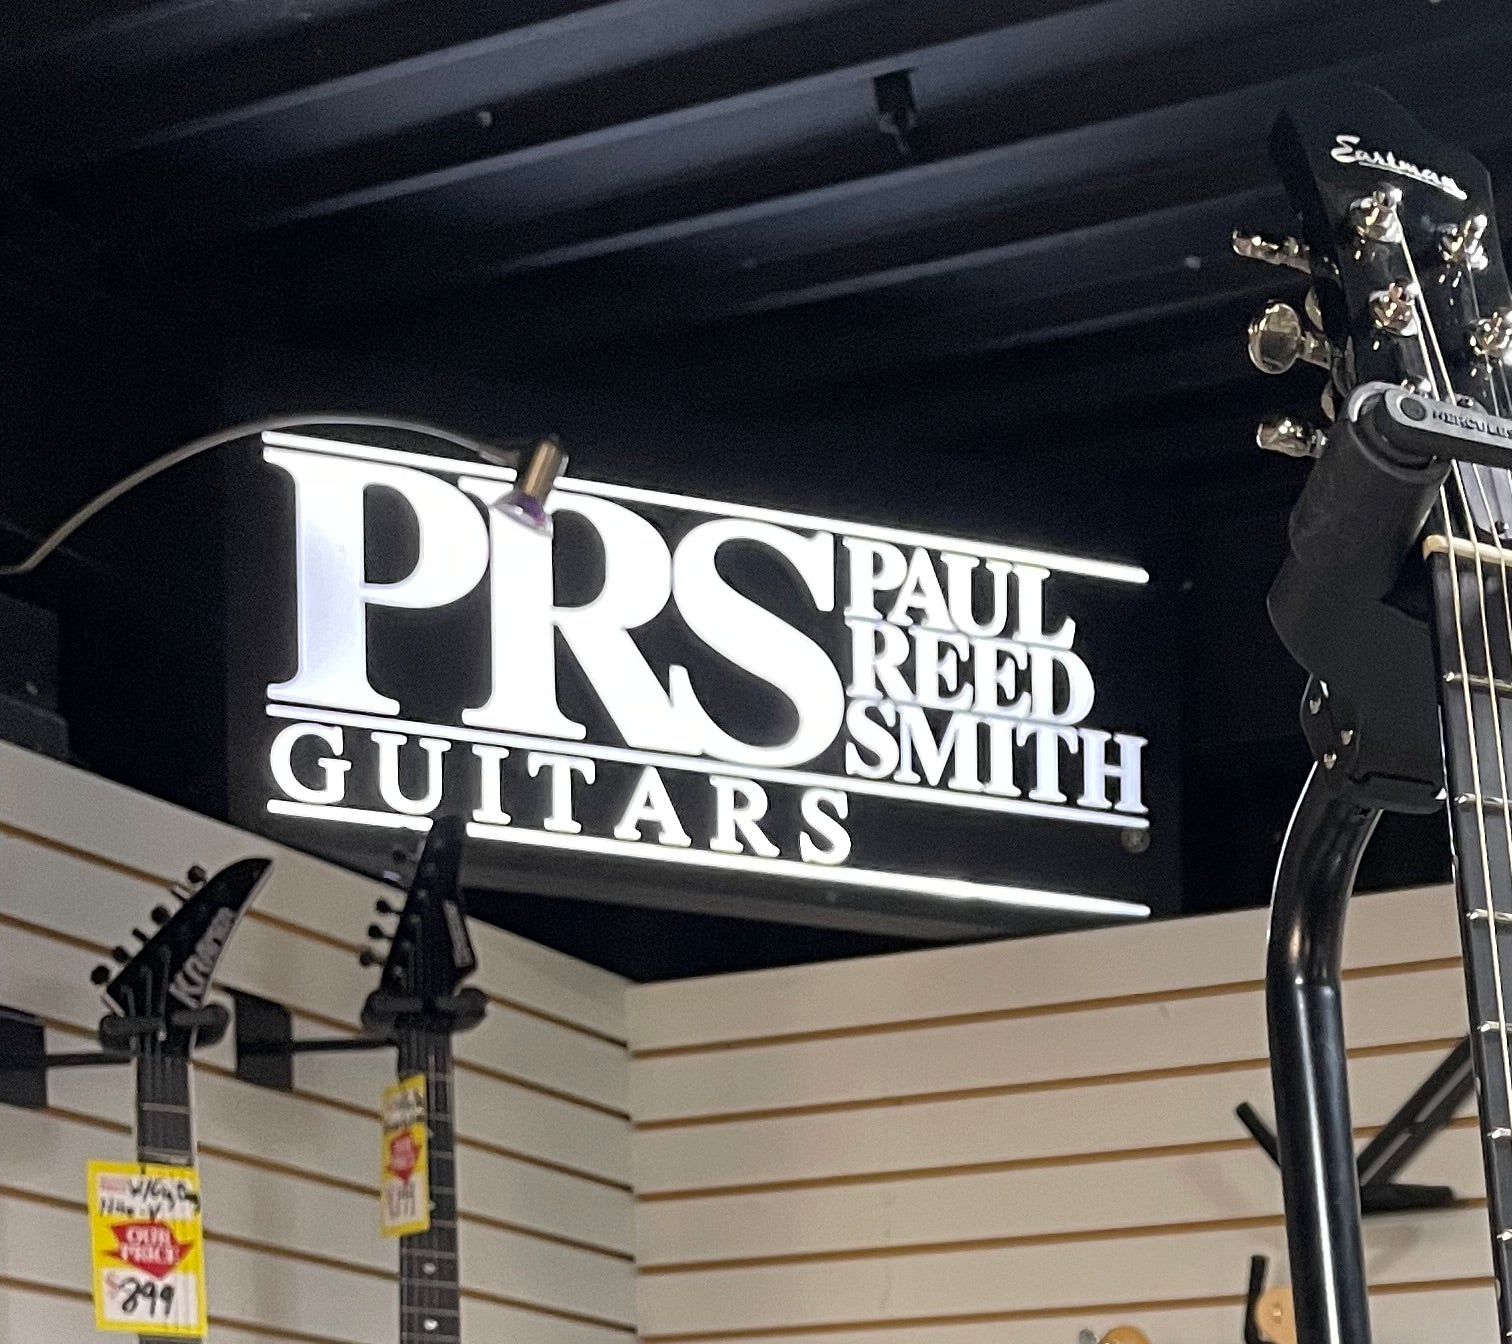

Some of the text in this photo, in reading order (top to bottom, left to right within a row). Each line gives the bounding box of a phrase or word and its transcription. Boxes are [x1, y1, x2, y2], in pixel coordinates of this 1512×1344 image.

[1331, 134, 1467, 200] Eastman
[264, 446, 845, 768] PRS
[842, 532, 1075, 648] PAUL
[845, 617, 1094, 726] REED
[269, 723, 853, 866] GUITARS
[845, 696, 1149, 815] SMITH
